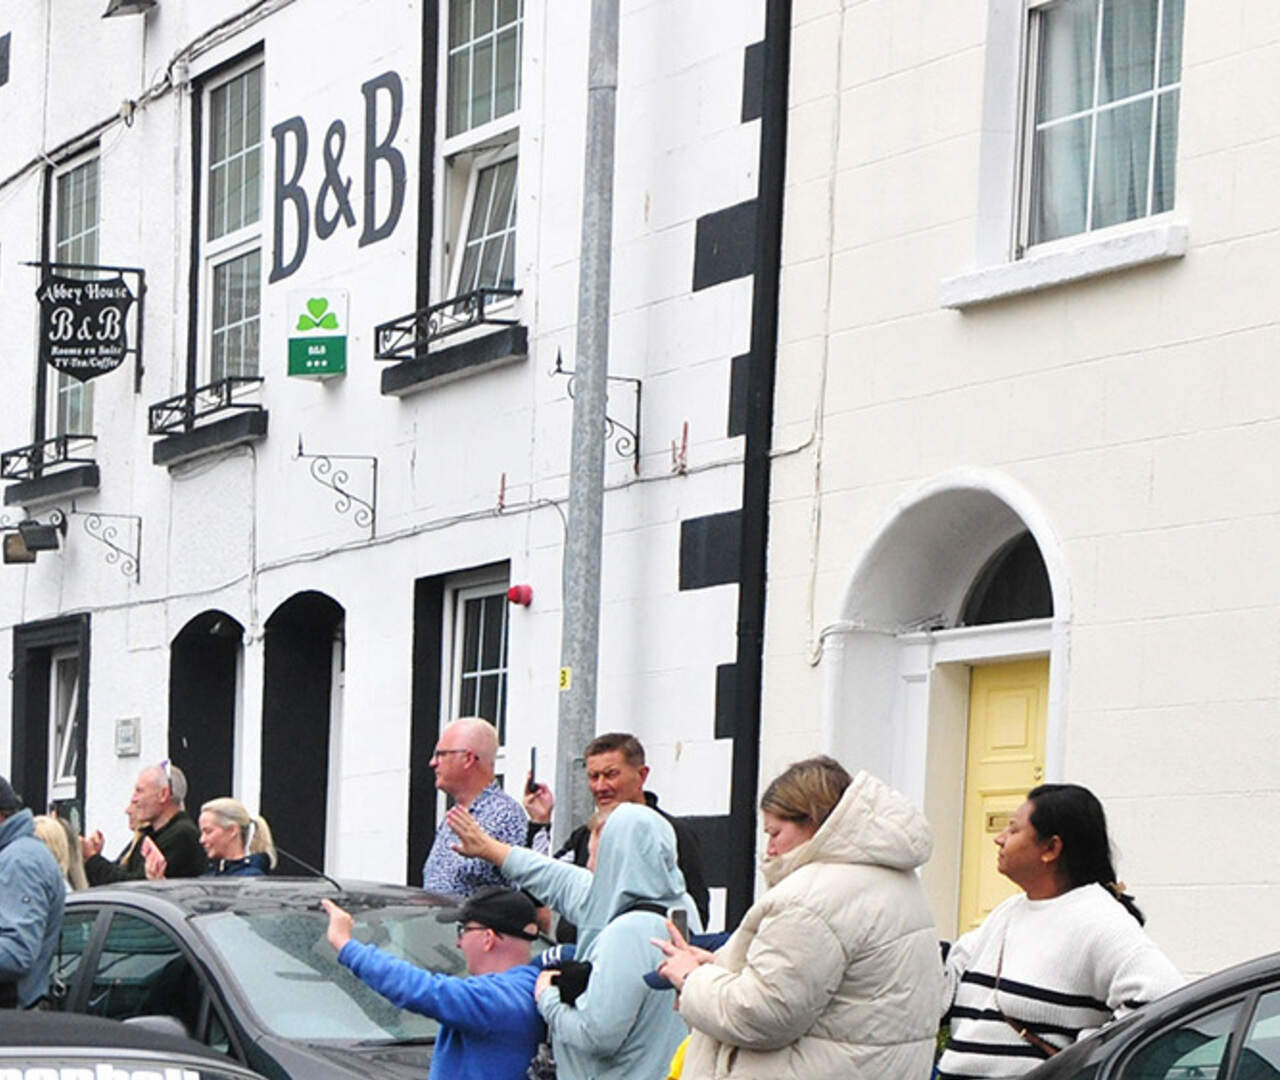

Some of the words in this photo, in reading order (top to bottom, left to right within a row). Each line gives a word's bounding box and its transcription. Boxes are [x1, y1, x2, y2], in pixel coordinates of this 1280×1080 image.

[269, 70, 407, 284] B&B
[40, 283, 81, 305] Abbey
[85, 283, 127, 299] House
